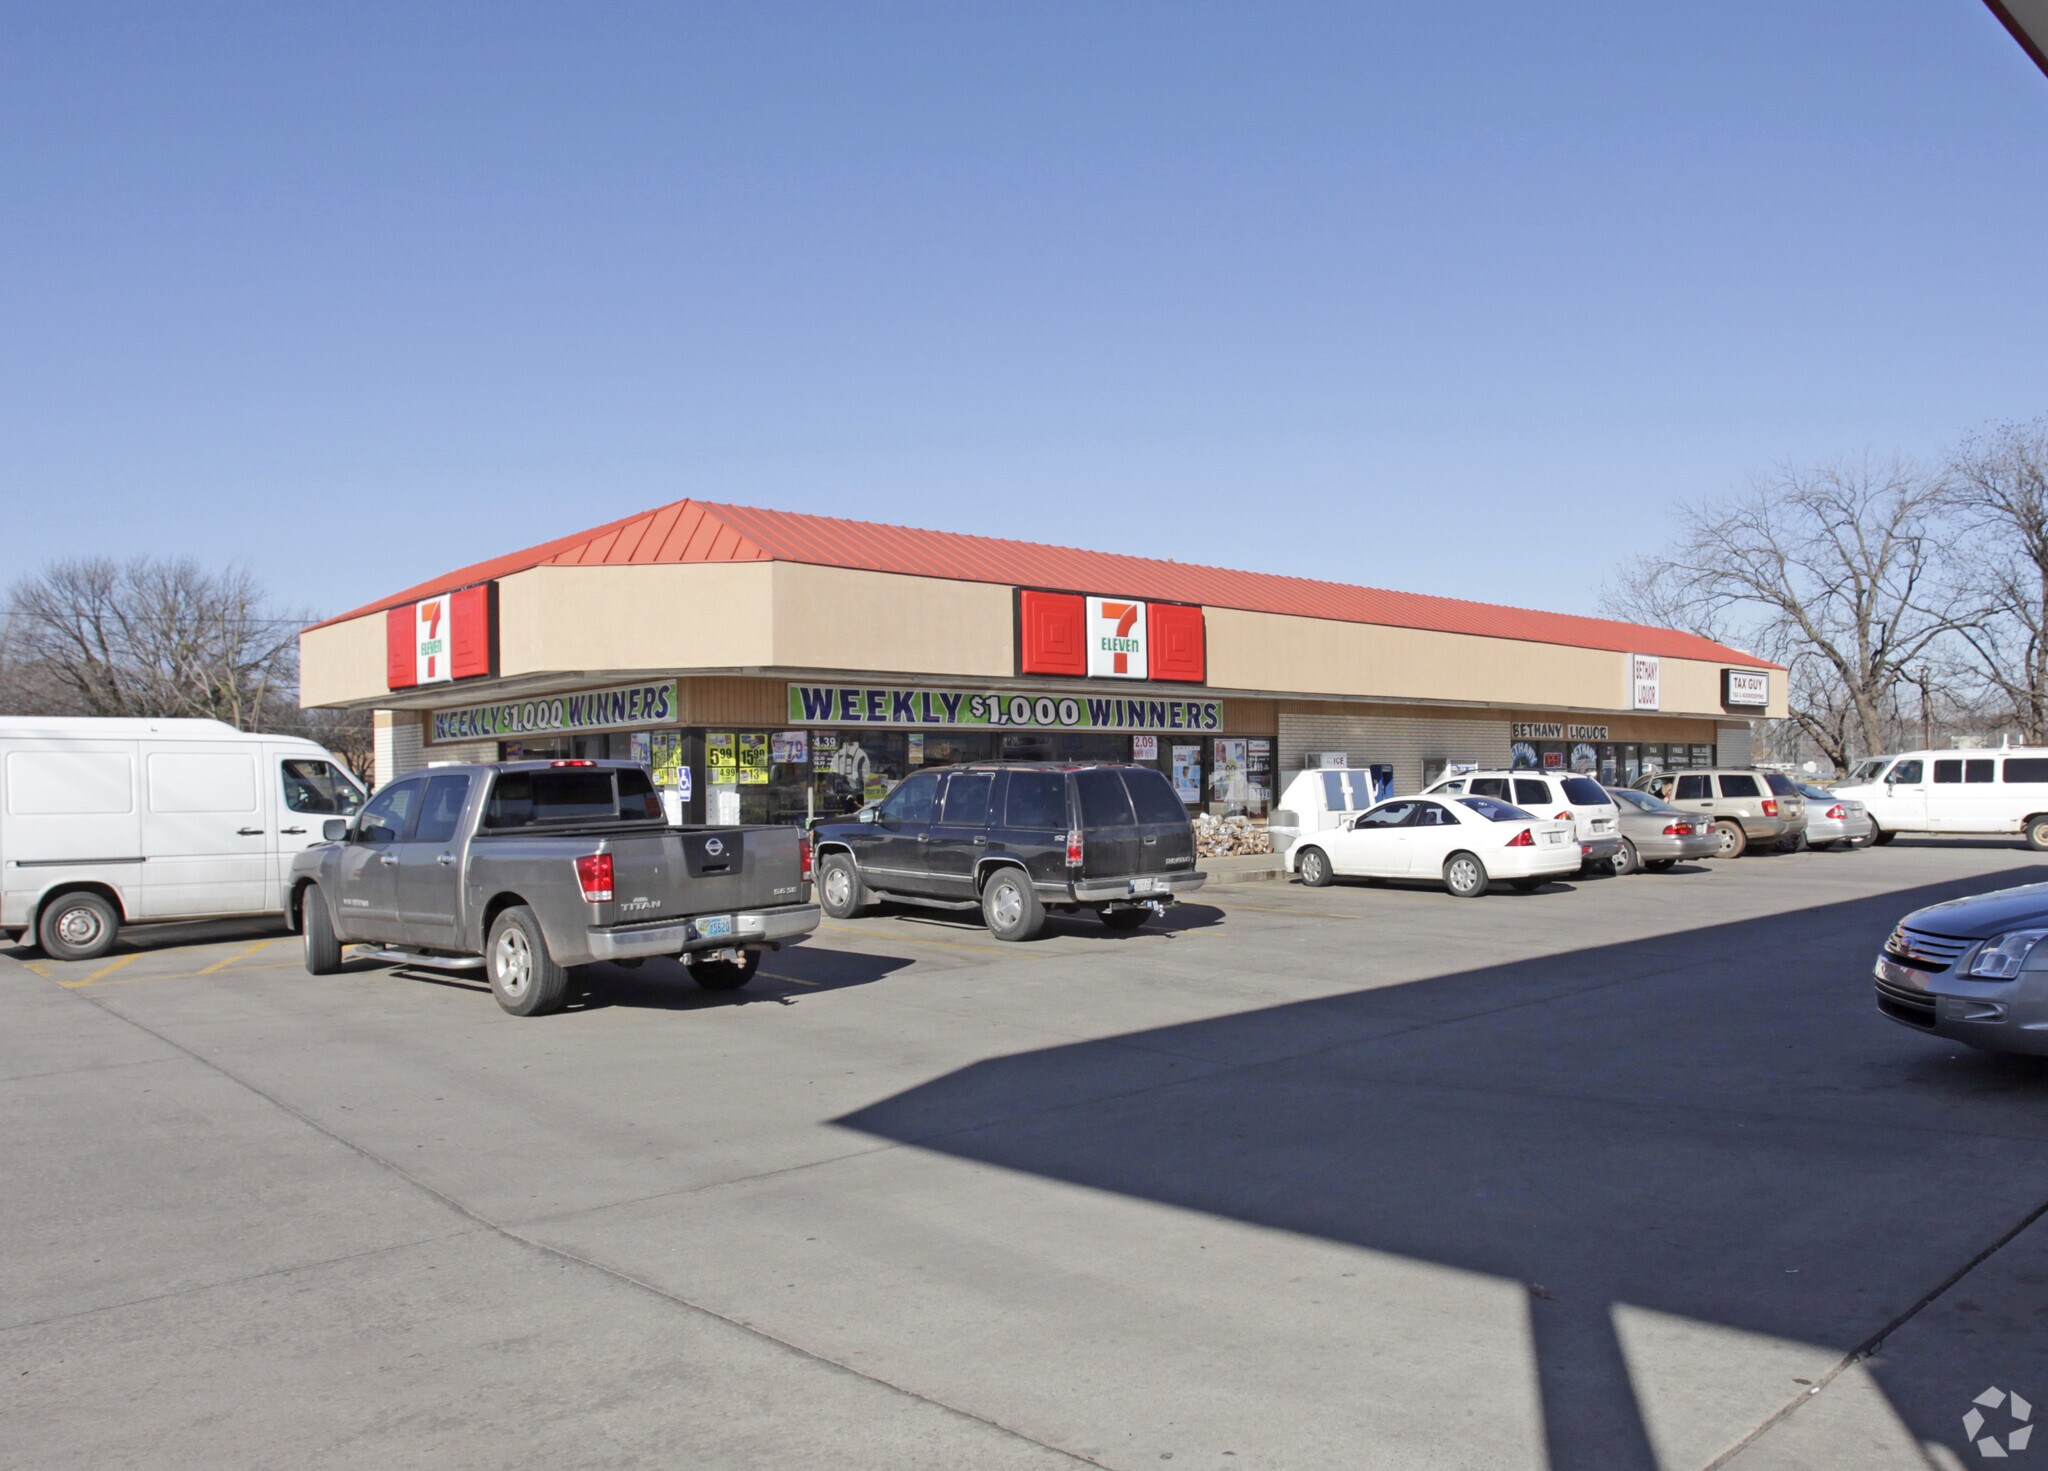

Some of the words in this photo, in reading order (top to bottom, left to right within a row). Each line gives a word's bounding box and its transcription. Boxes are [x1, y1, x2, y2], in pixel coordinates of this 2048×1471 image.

[422, 601, 441, 678] 7
[1102, 602, 1138, 673] 7
[1636, 661, 1658, 680] BETHANY
[1734, 677, 1747, 689] TAX
[1748, 679, 1763, 690] GUY
[1638, 686, 1656, 704] LIQUOR
[436, 706, 500, 738] WEEKLY
[568, 685, 670, 727] WINNERS
[800, 687, 964, 724] WEEKLY
[969, 694, 1081, 727] $1,000
[1087, 698, 1218, 730] WINNERS
[1512, 723, 1562, 738] BETHANY
[1570, 726, 1607, 740] LIQUOR
[1135, 736, 1154, 748] 2.09
[1333, 757, 1344, 765] ICE
[621, 901, 661, 911] TITAN
